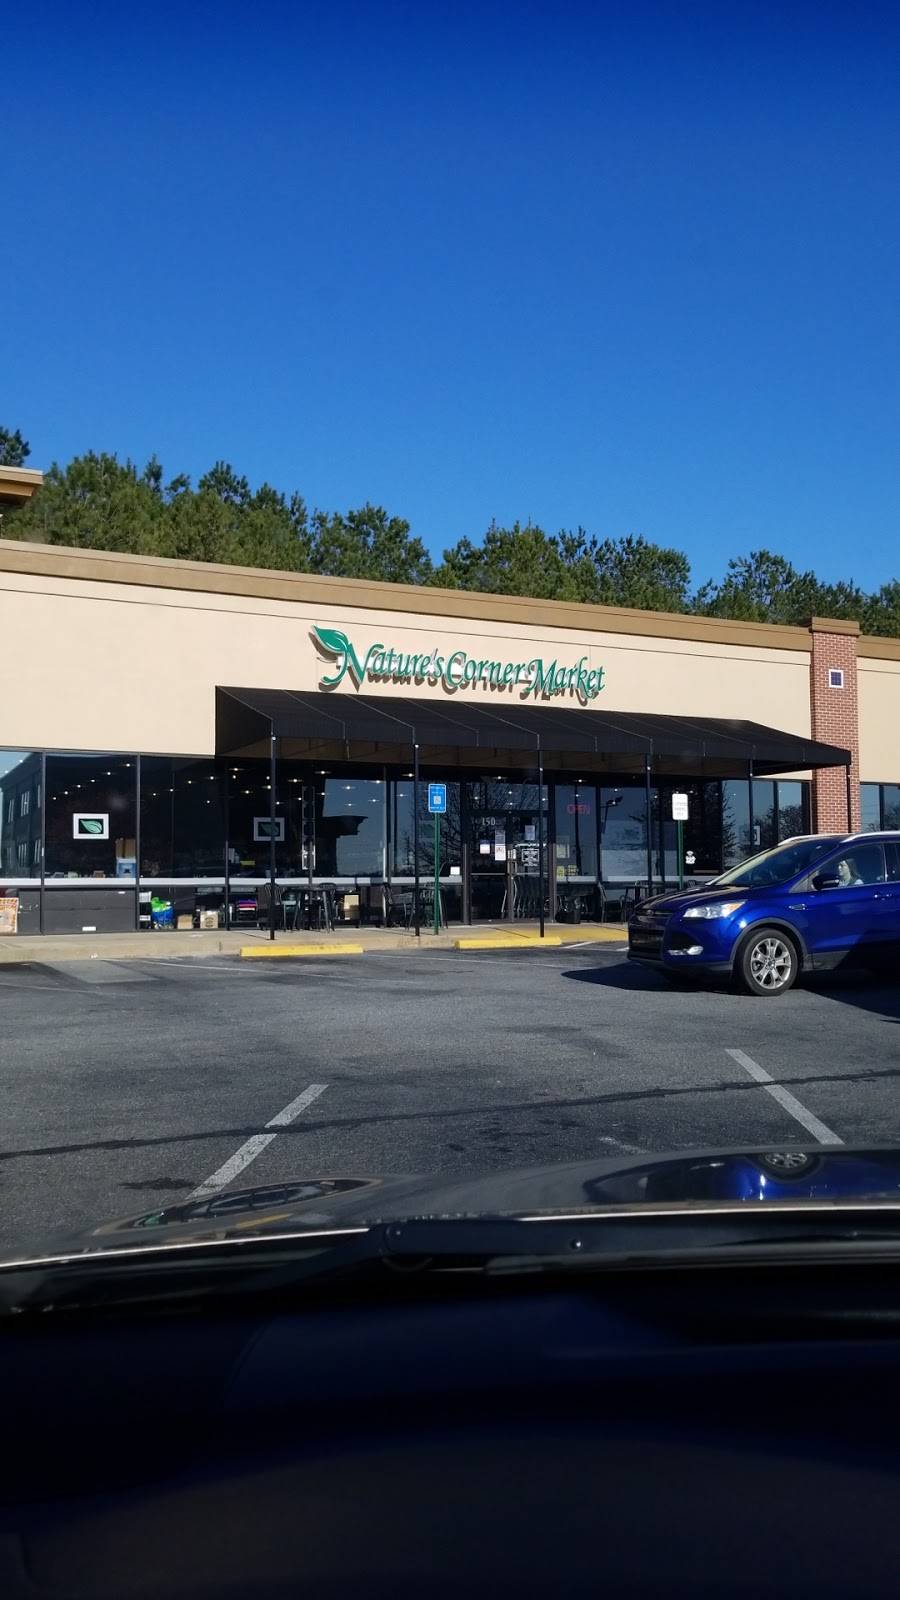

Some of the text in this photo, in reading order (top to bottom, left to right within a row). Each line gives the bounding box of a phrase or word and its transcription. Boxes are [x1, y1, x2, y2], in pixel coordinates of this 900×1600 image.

[320, 638, 605, 699] Nature's Corner Market
[481, 816, 496, 826] 150
